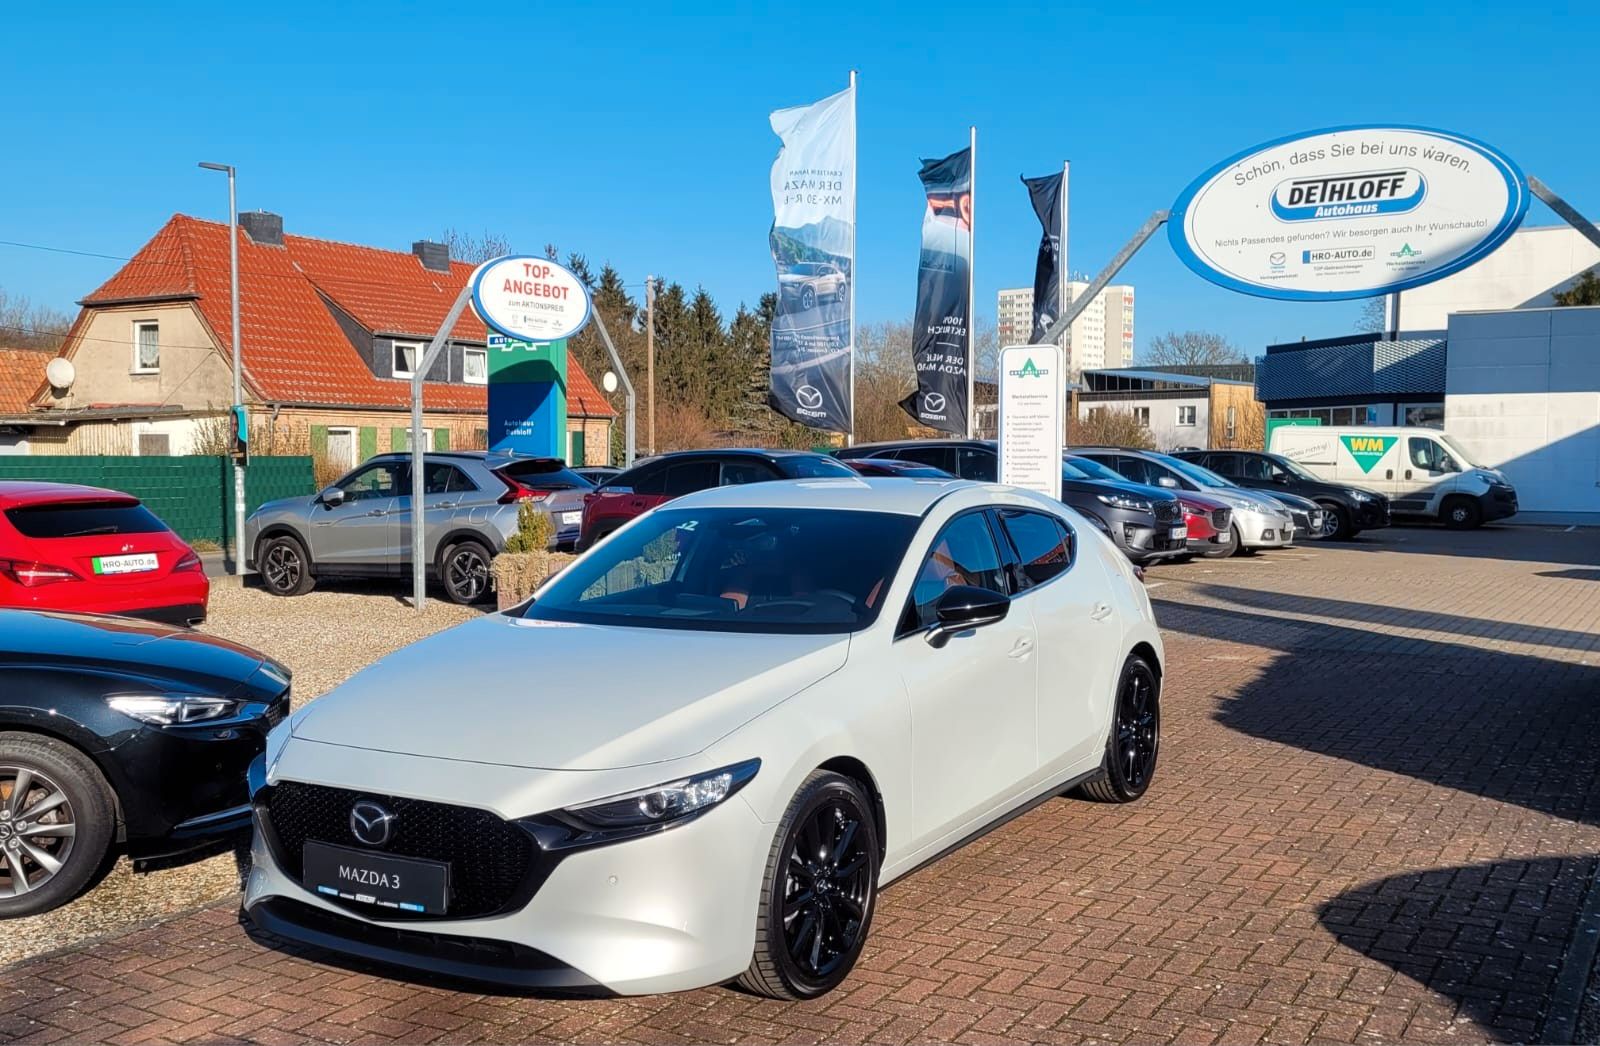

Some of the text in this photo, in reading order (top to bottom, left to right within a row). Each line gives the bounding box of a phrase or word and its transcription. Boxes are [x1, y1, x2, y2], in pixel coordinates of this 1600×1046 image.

[1234, 141, 1471, 186] Schön, dass Sie bei uns waren.
[1287, 174, 1406, 206] DETHLOFF
[1314, 202, 1379, 218] Autohaus
[1215, 218, 1488, 248] Nichts Passendes gefunden? Wir besorgen auch Ihr Wunschauto!
[1311, 248, 1373, 261] HRO-AUTO.de
[522, 263, 555, 279] TOP-
[503, 278, 569, 301] ANGEBOT
[508, 300, 565, 313] zum AKTIONSPREIS
[1350, 437, 1384, 452] WM
[102, 558, 155, 569] HRO-AUTO.de
[338, 864, 401, 889] MAZDA 3
